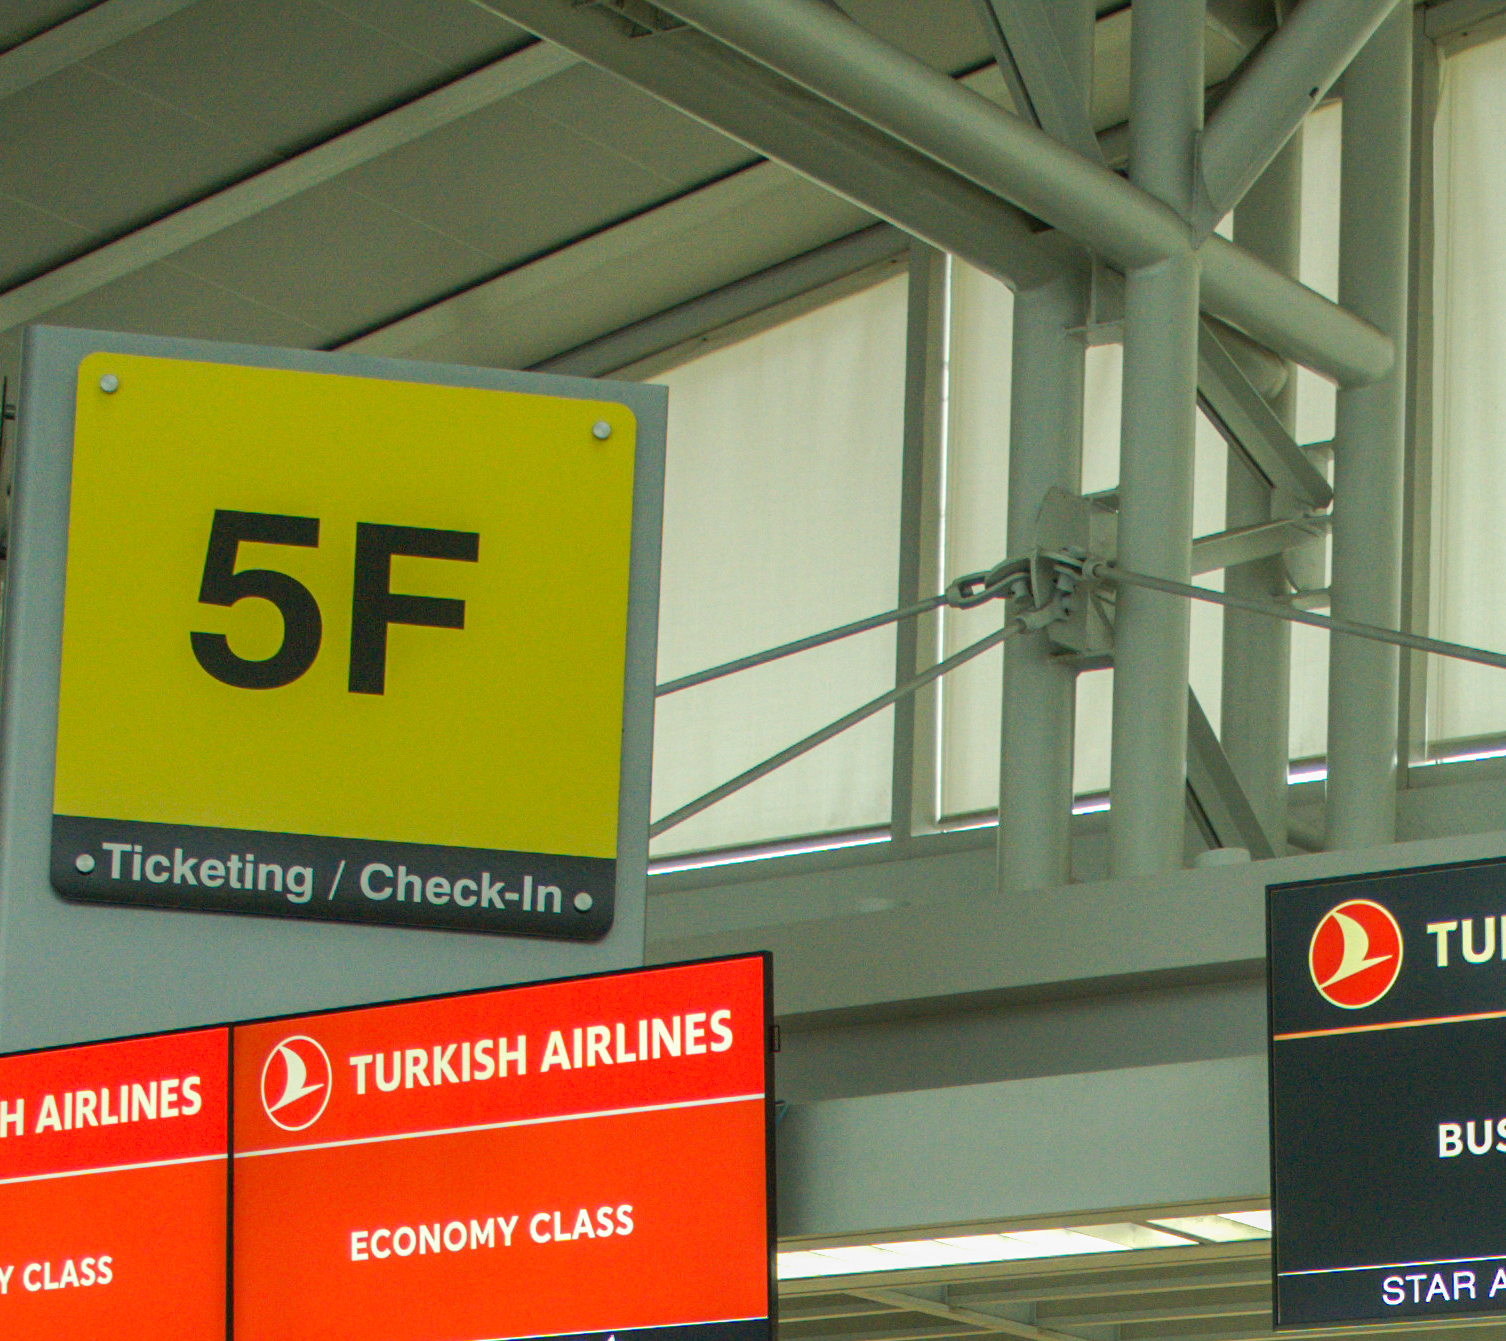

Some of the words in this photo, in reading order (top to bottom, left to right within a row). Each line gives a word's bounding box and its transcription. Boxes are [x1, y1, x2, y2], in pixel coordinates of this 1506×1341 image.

[190, 509, 480, 695] 5F
[102, 842, 314, 903] Ticketing
[360, 863, 562, 914] Check-In
[349, 1034, 527, 1096] TURKISH
[540, 1008, 735, 1074] AIRLINES
[33, 1075, 203, 1137] AIRLINES
[349, 1216, 519, 1263] ECONOMY
[528, 1204, 635, 1246] CLASS
[22, 1255, 113, 1295] CLASS
[1382, 1272, 1476, 1306] STAR
